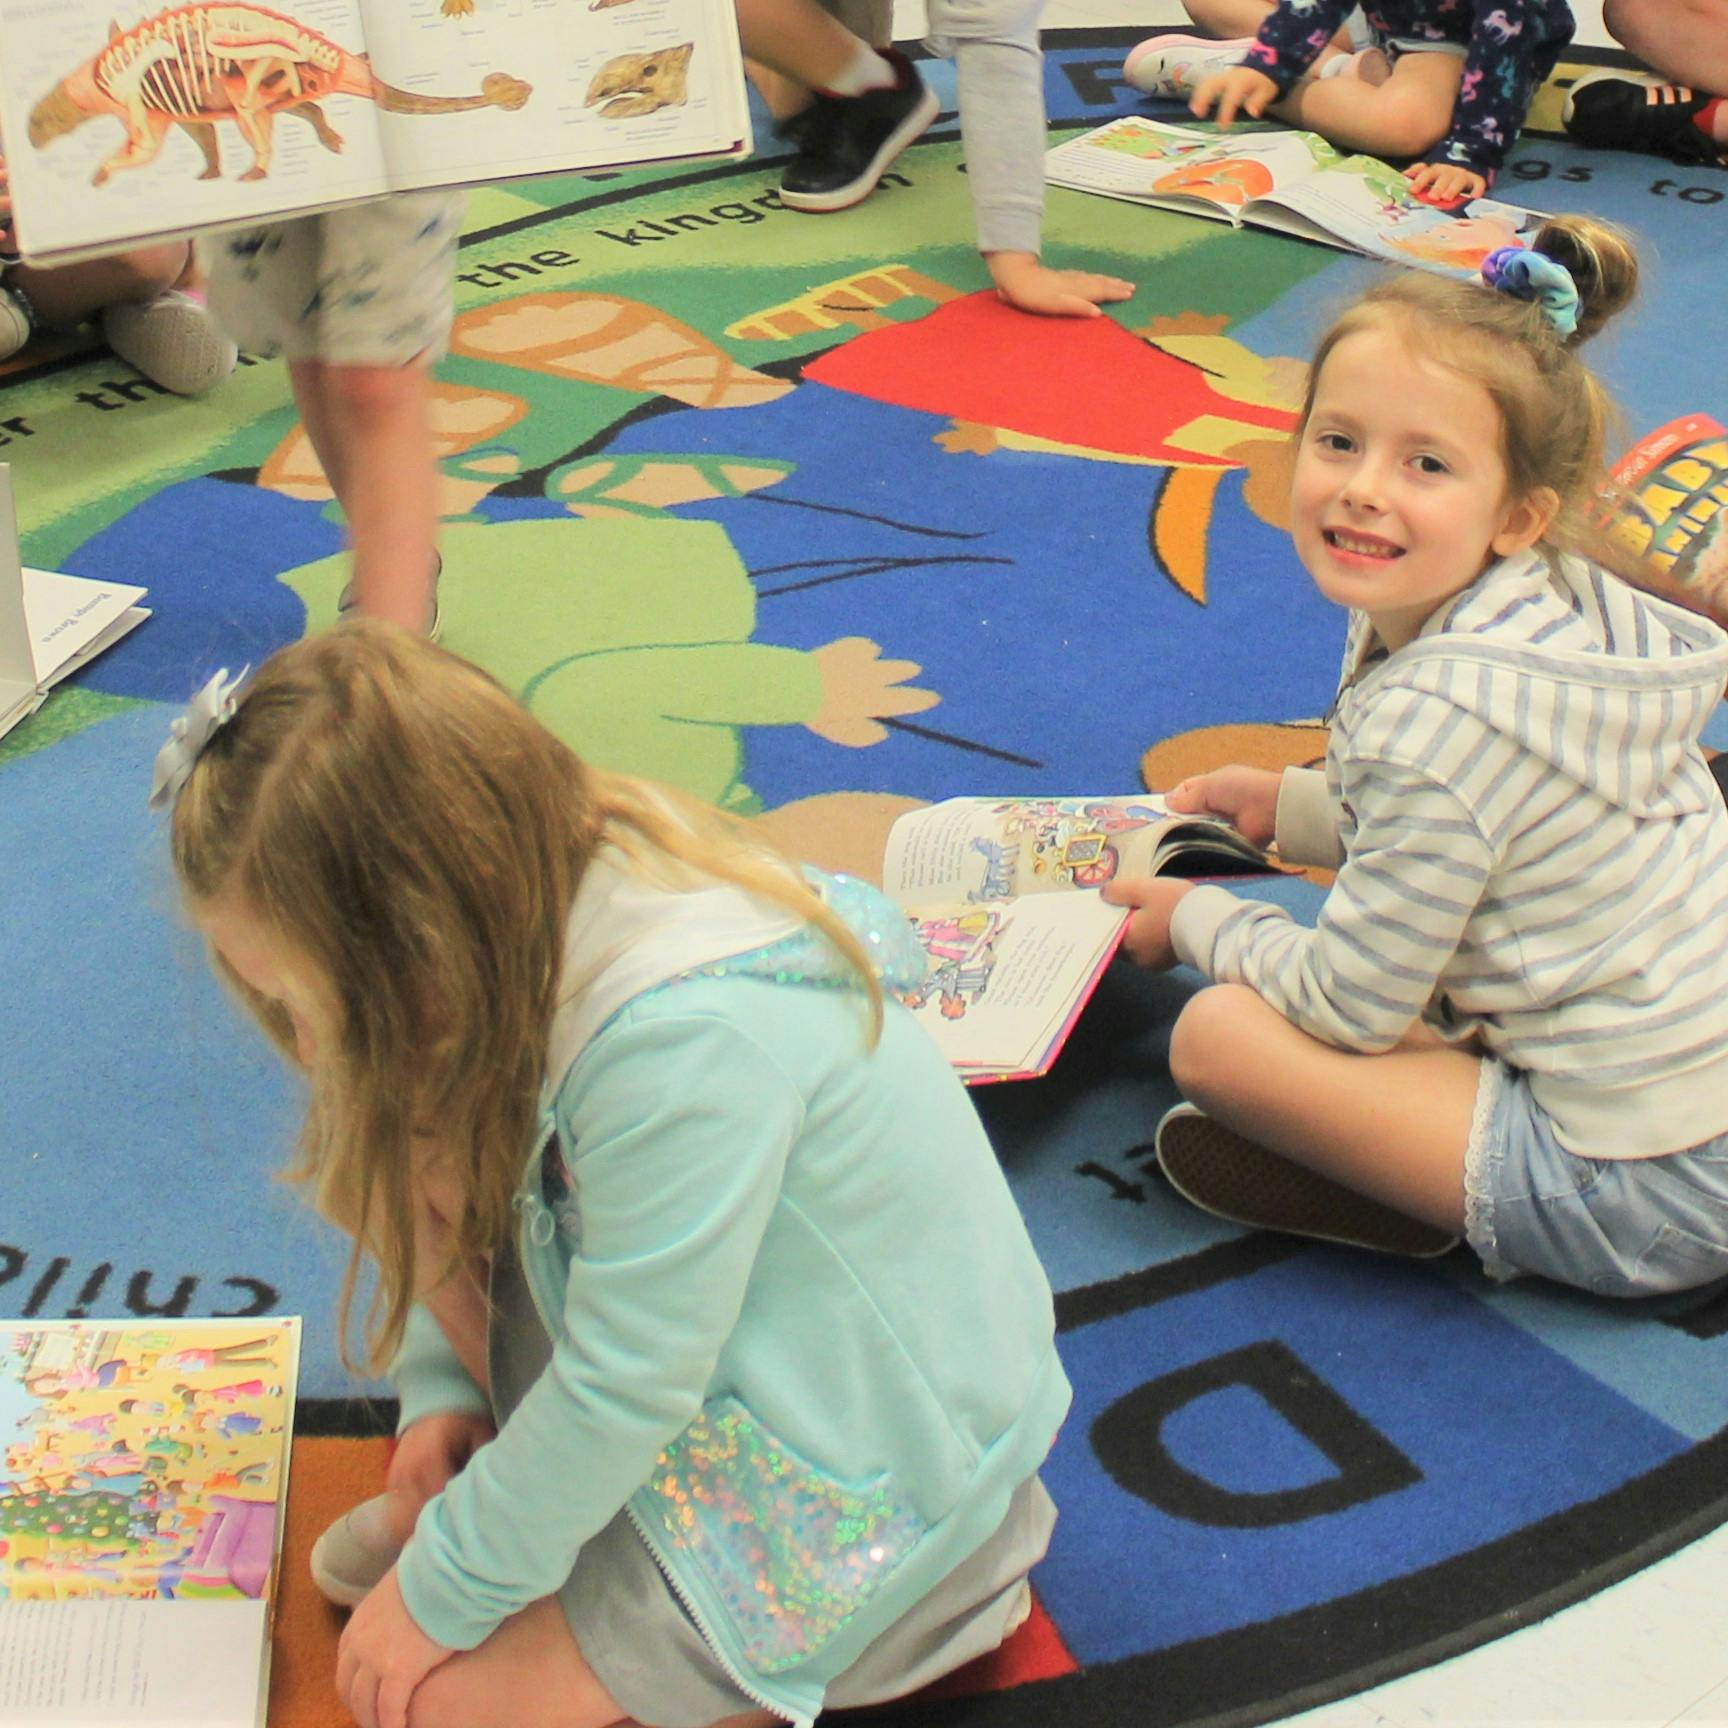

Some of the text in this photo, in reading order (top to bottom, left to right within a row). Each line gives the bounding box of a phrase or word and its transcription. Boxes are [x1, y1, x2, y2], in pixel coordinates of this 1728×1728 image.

[1648, 177, 1725, 206] to
[456, 248, 579, 290] the
[1088, 1338, 1426, 1531] D
